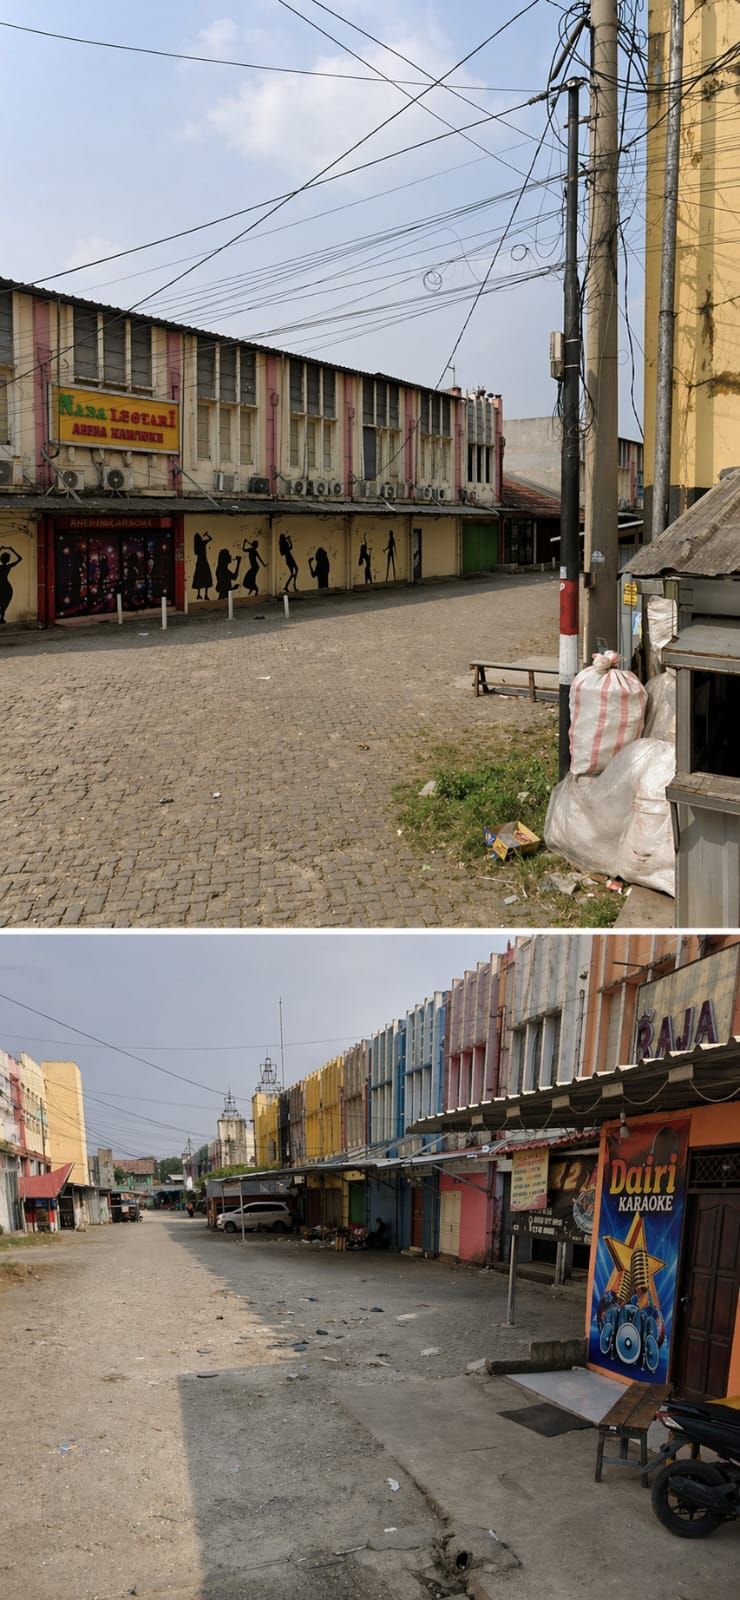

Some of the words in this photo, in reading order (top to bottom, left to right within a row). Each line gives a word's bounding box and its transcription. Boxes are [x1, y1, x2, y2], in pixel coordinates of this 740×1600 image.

[636, 1000, 719, 1059] RAJA
[609, 1153, 678, 1196] Dairi
[618, 1195, 674, 1212] KARAOKE
